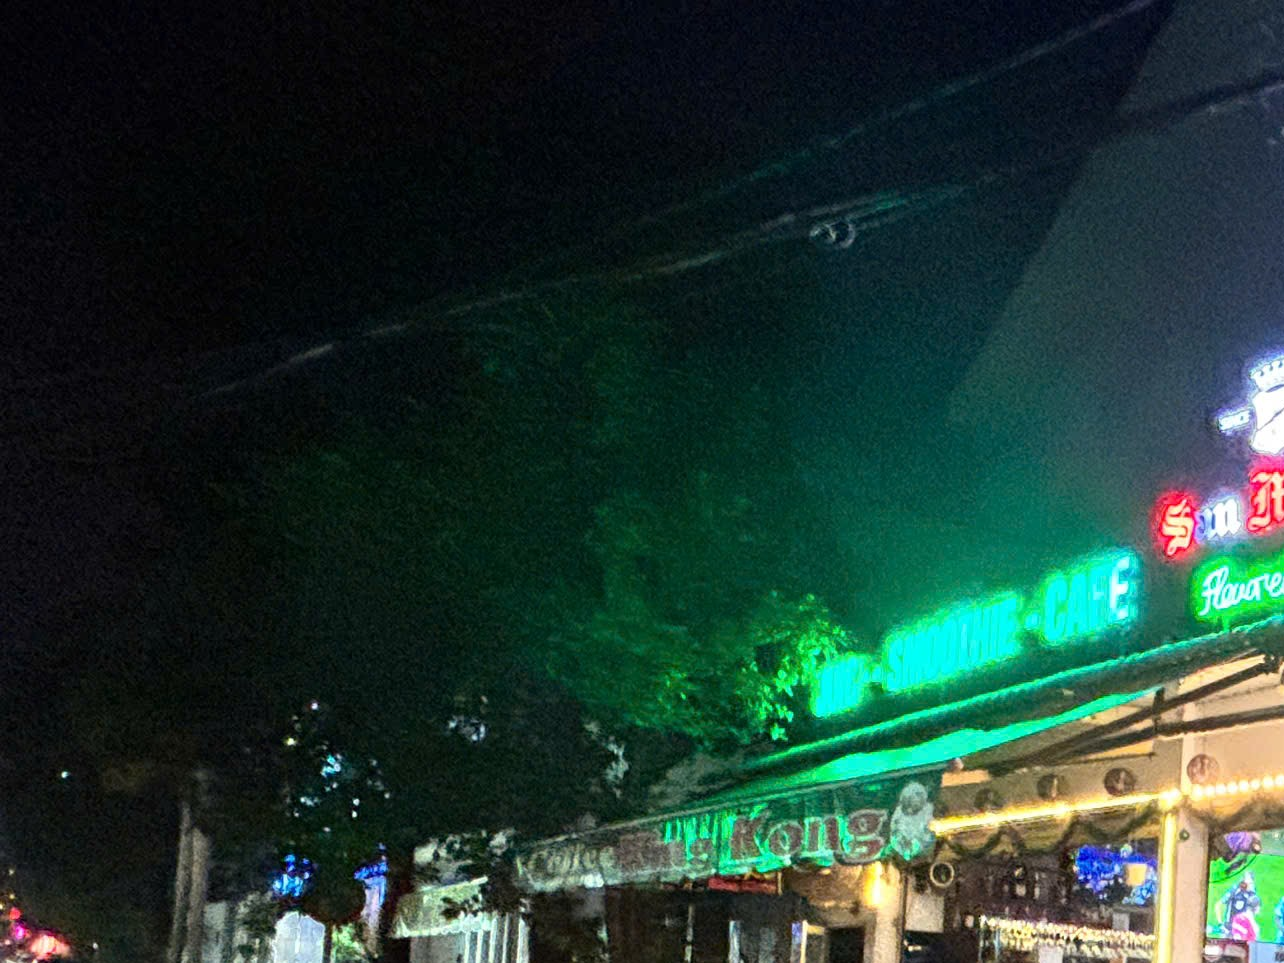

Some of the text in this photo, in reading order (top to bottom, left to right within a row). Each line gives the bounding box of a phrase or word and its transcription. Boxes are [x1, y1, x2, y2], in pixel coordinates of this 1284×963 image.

[1160, 498, 1241, 556] San
[1044, 555, 1132, 643] CAFE
[729, 808, 888, 866] Kong
